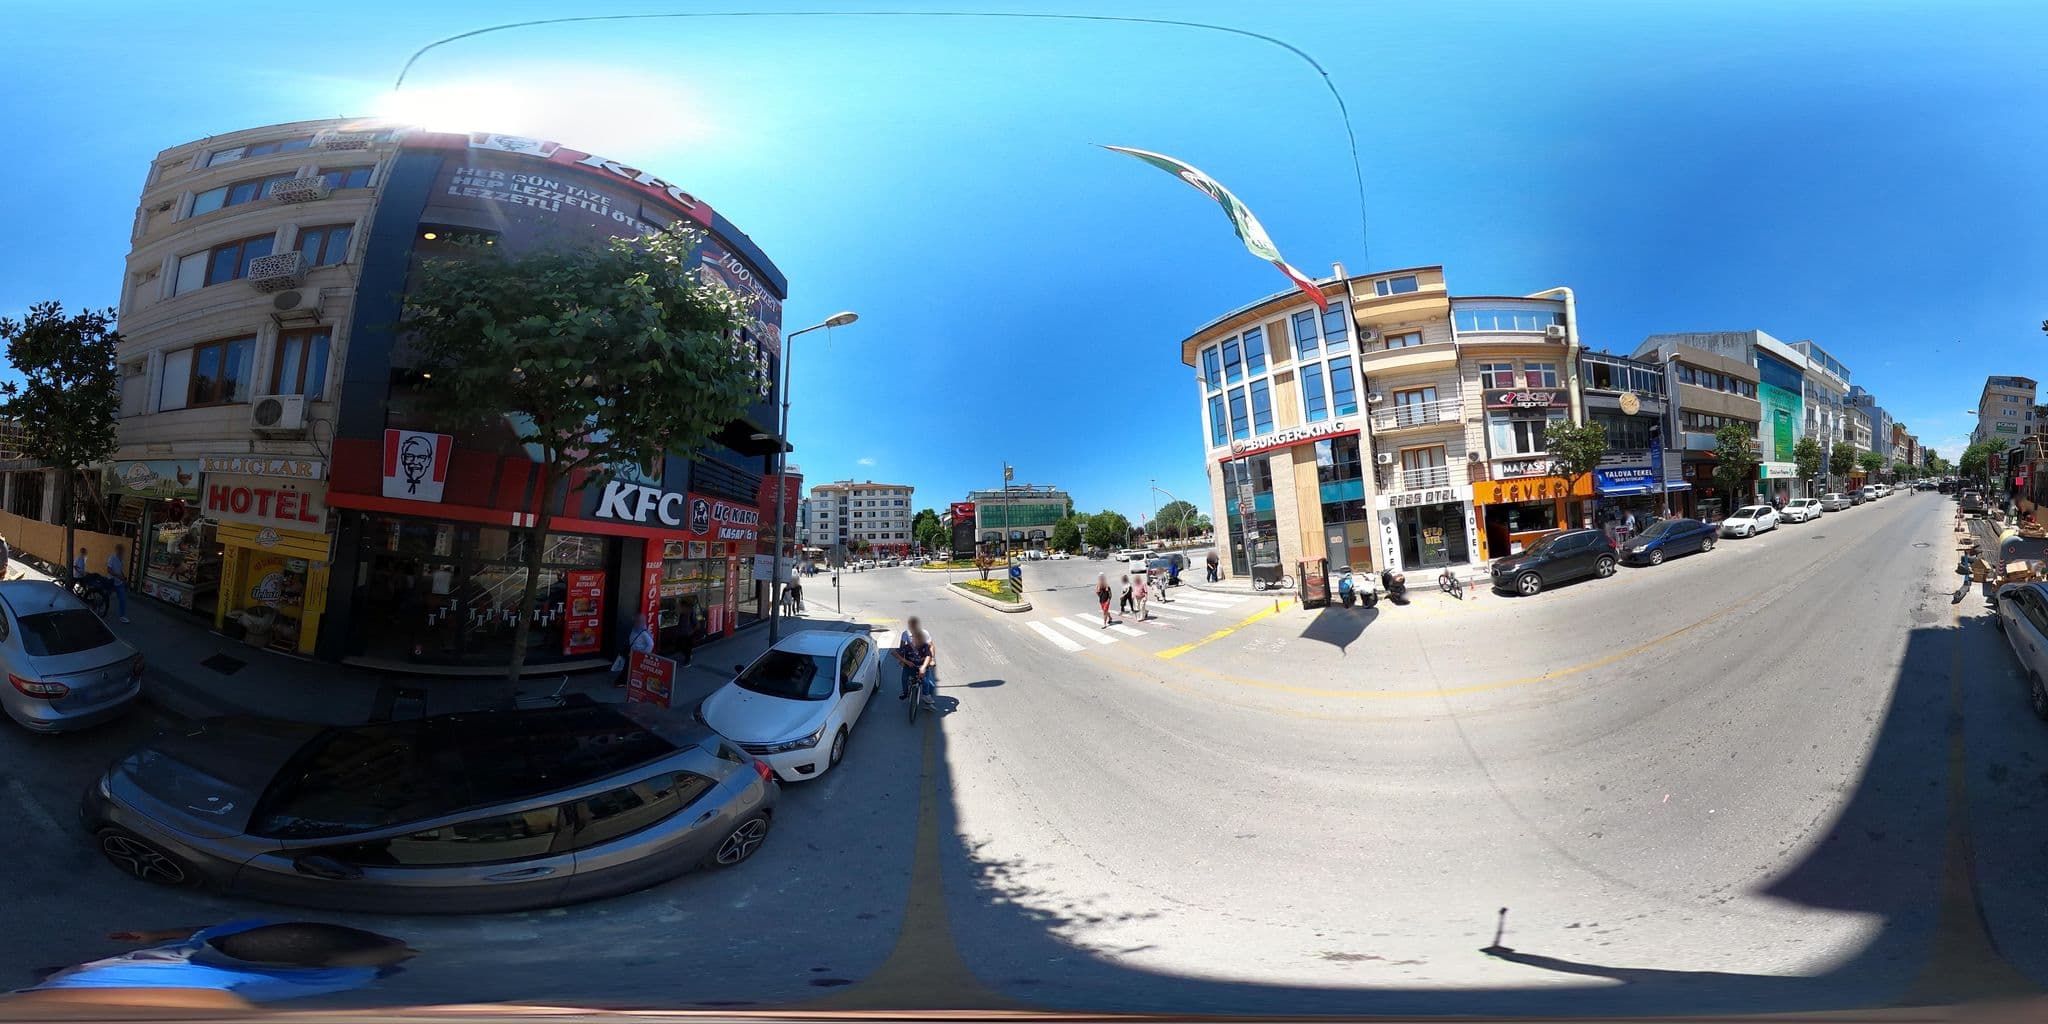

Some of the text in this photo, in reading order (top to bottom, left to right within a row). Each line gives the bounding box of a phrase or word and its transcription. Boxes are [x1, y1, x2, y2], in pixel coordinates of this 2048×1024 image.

[575, 155, 701, 210] KFC
[565, 185, 611, 206] TAZE
[1250, 421, 1345, 450] BURGER KING
[1605, 471, 1631, 479] YALOVA
[595, 480, 683, 526] KFC
[1425, 489, 1457, 502] OTEL
